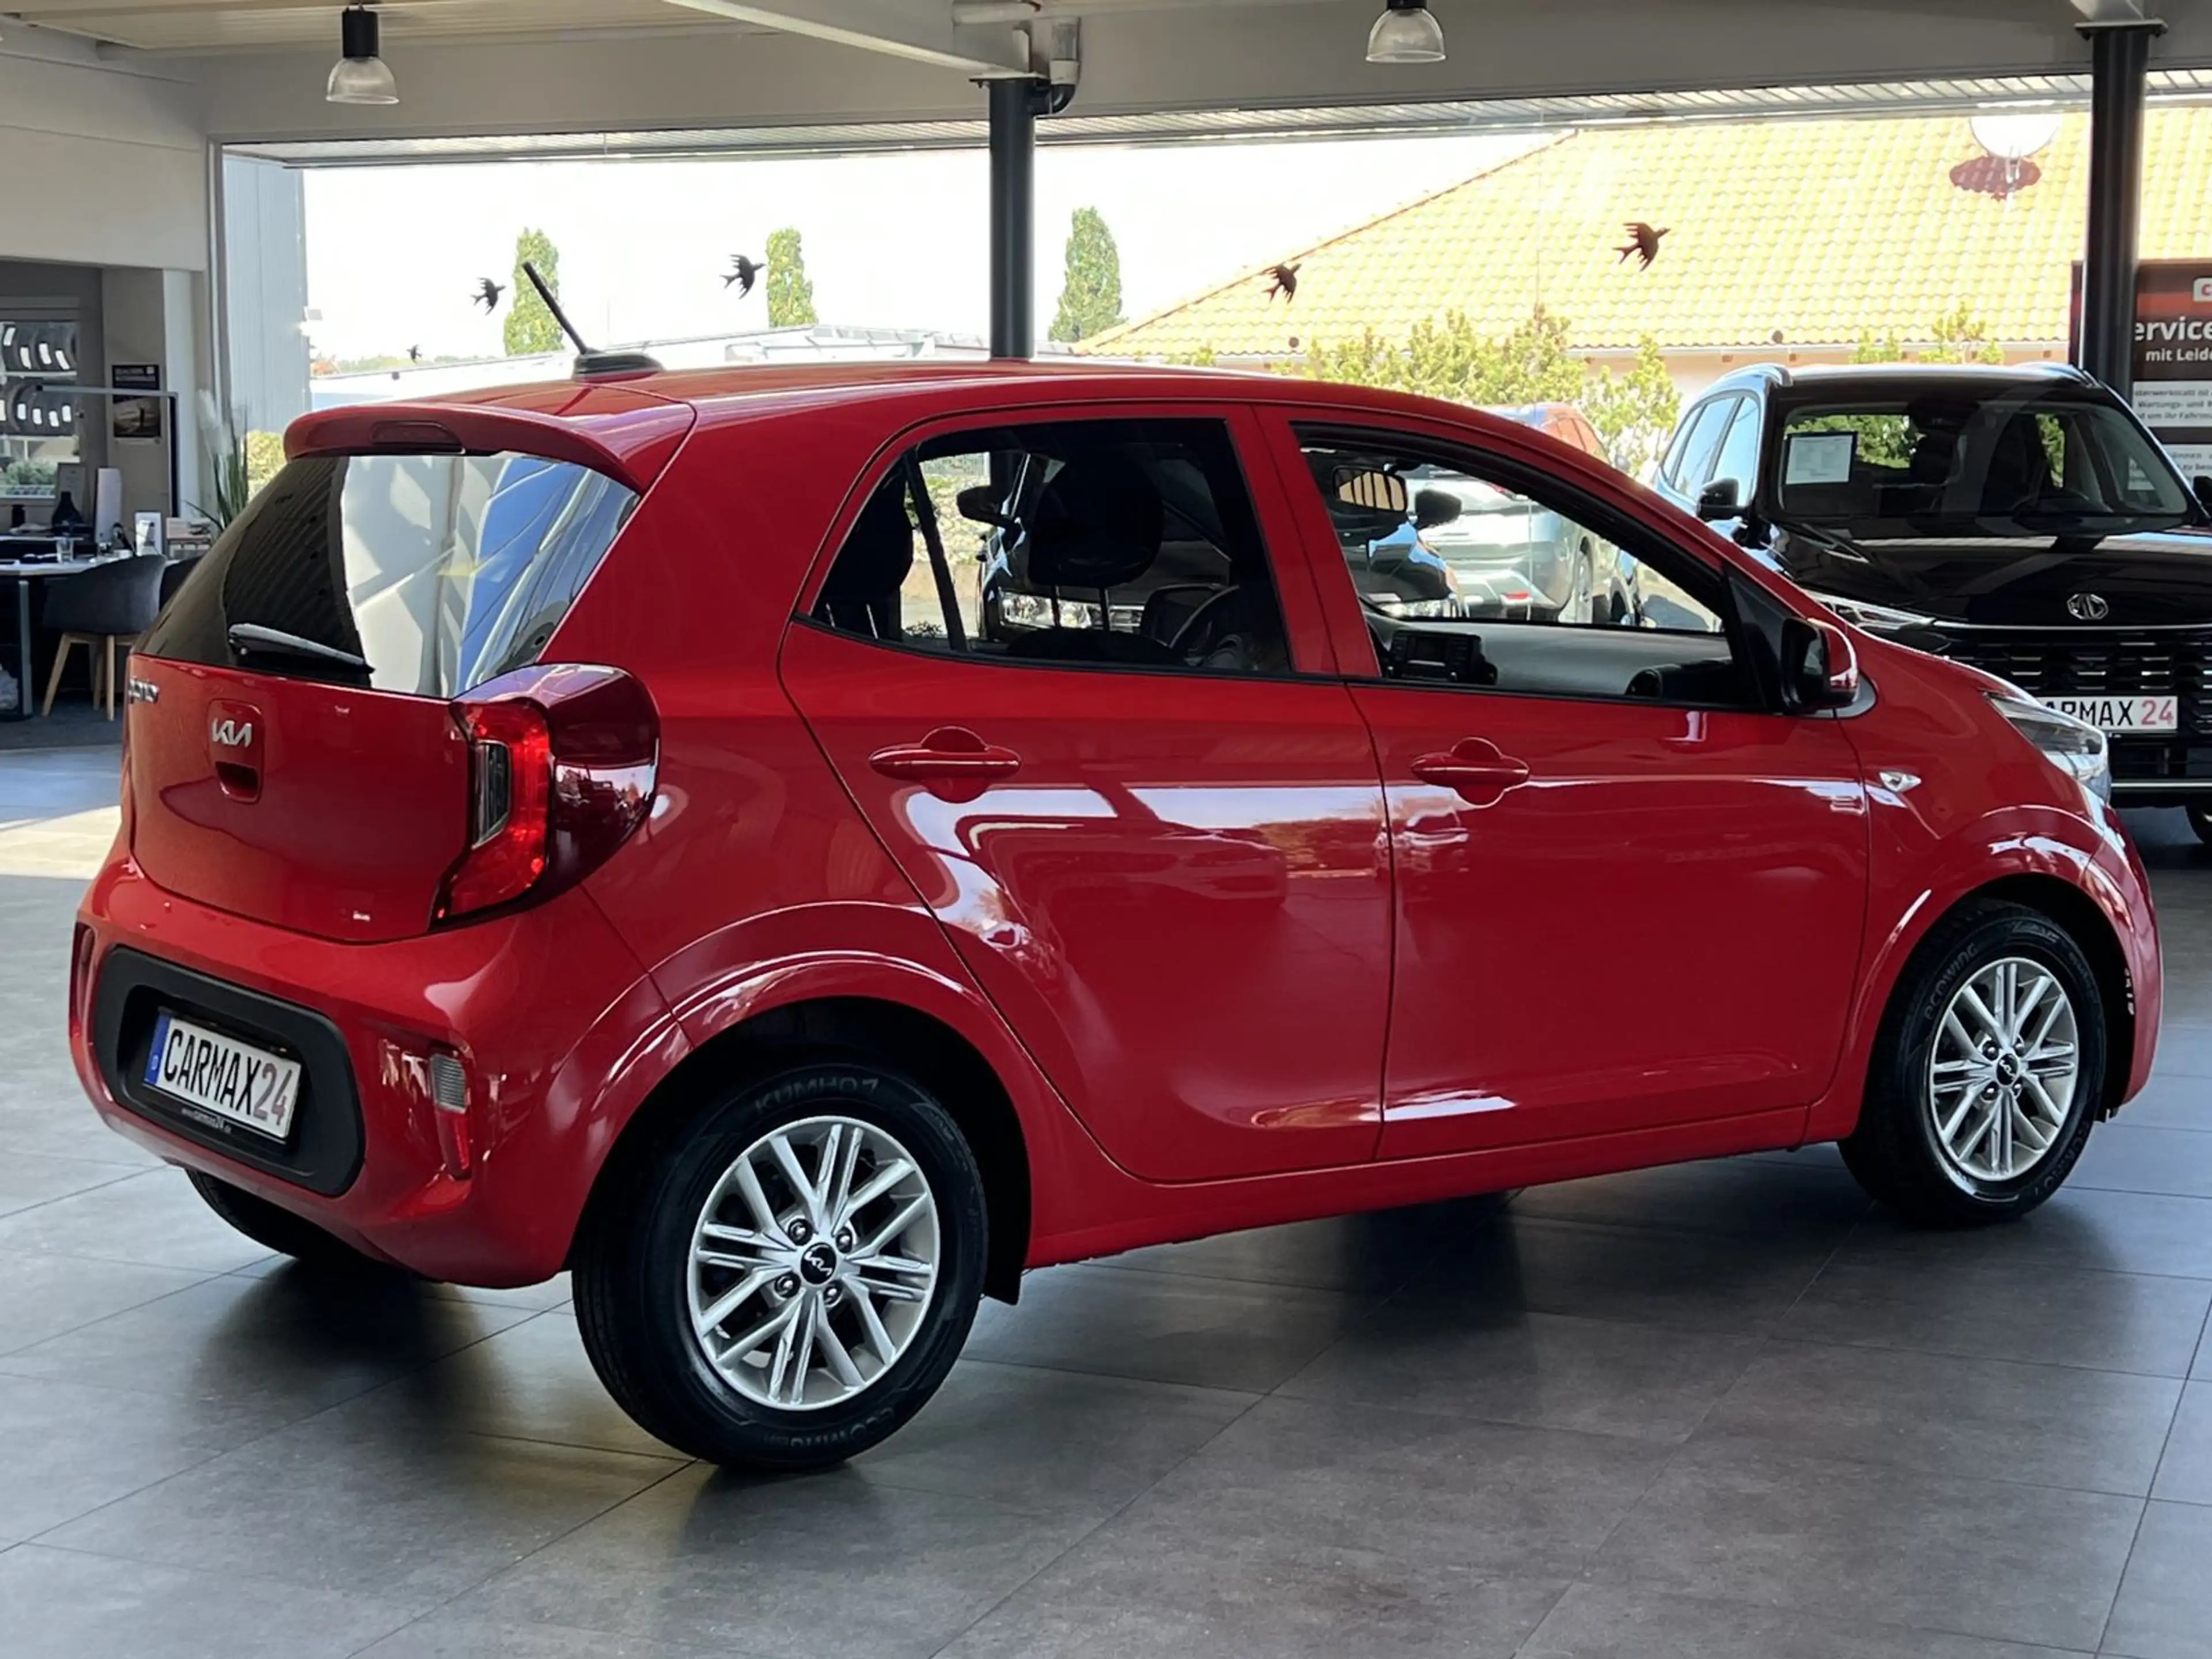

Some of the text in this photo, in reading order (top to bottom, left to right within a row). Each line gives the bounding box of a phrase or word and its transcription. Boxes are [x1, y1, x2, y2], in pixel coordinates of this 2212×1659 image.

[2134, 316, 2212, 341] ervice
[2145, 348, 2173, 362] mit
[164, 1028, 293, 1126] CARMAX24
